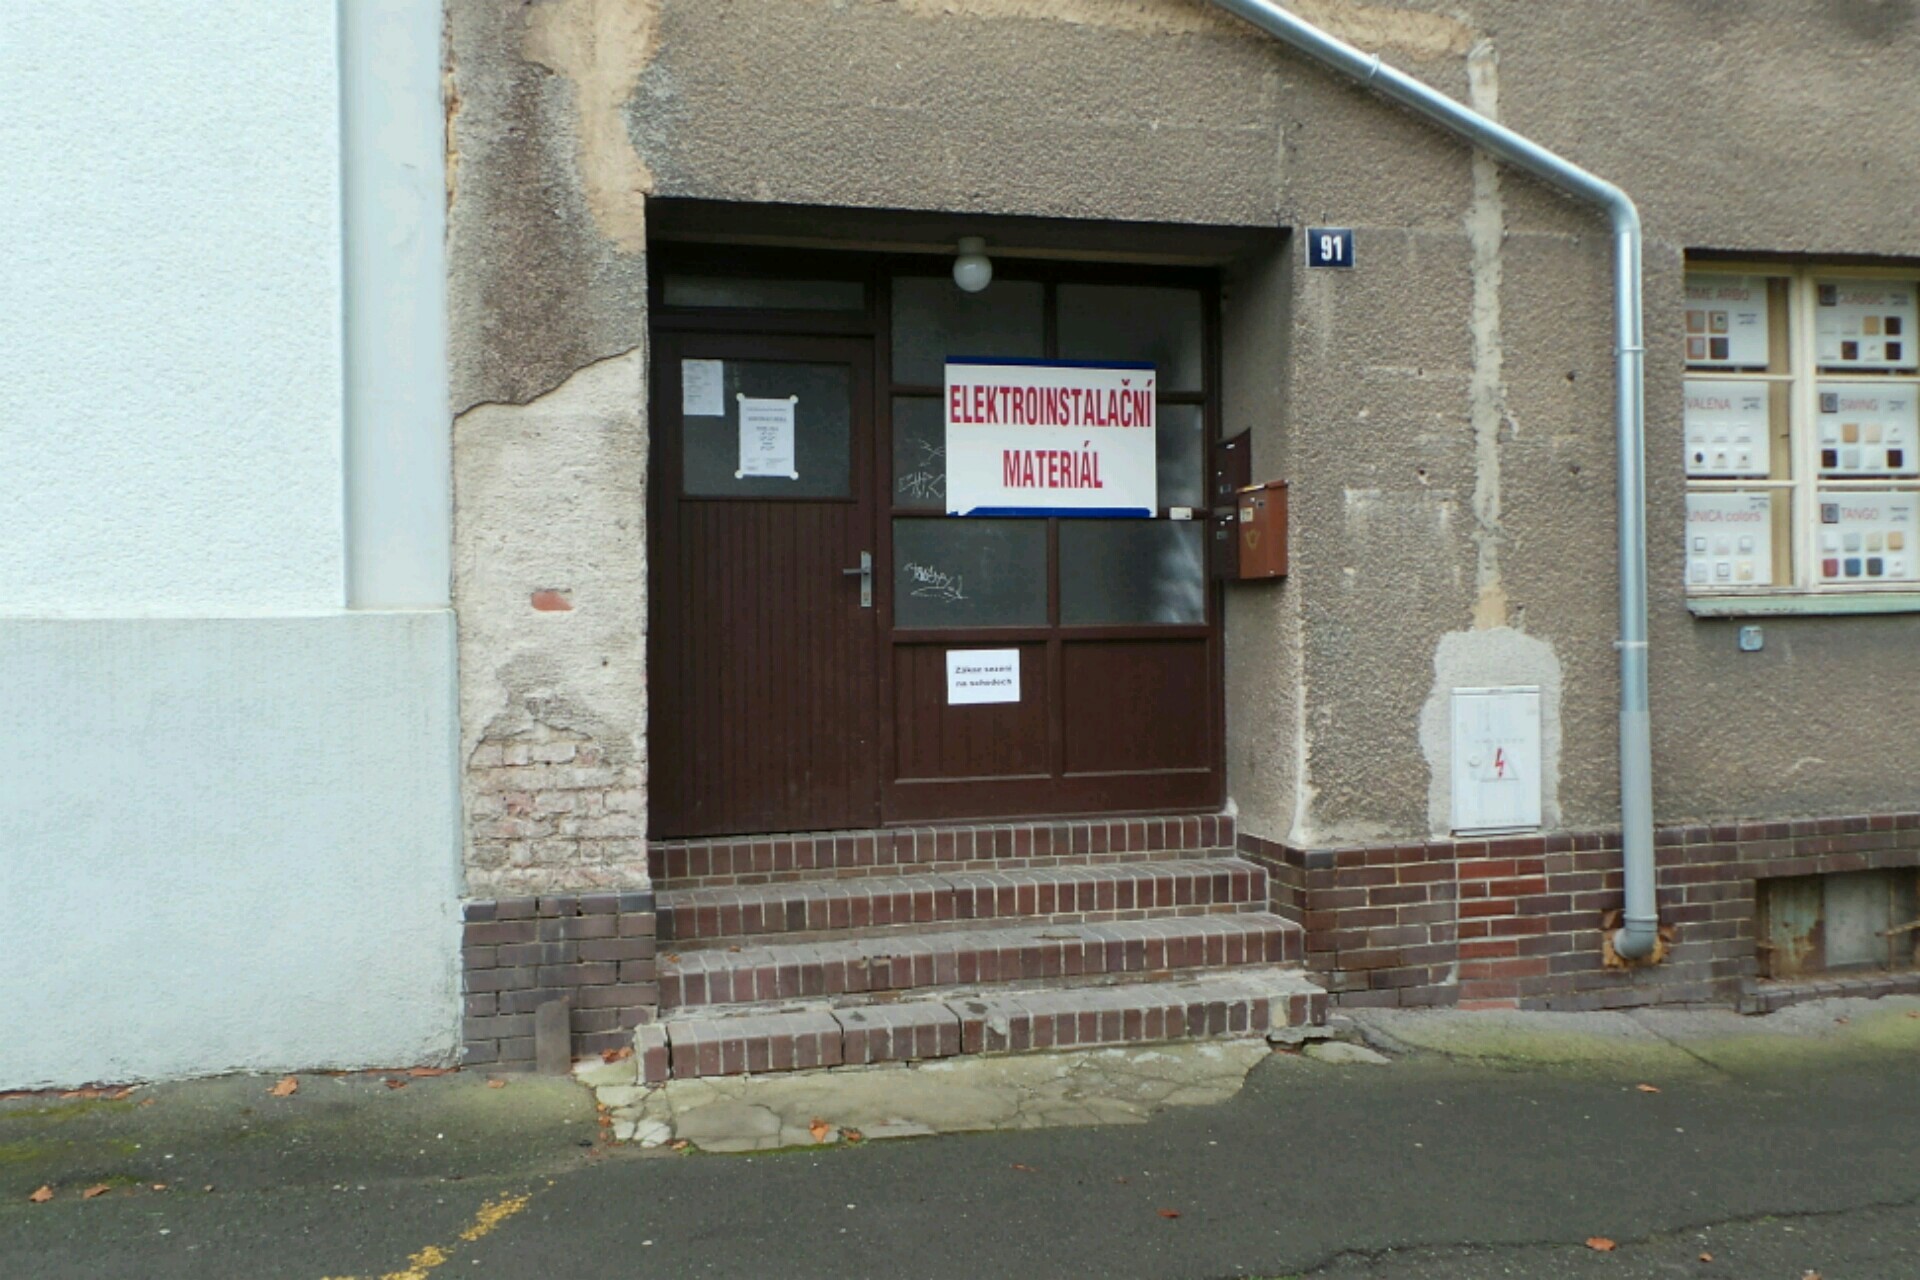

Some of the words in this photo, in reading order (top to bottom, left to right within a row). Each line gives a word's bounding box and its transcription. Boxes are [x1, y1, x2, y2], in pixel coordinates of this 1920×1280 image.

[1321, 235, 1342, 261] 91
[950, 379, 1153, 427] ELEKTROINSTALAČNÍ
[1687, 397, 1731, 410] VALENA
[1840, 398, 1878, 412] SWING
[1003, 440, 1103, 489] MATERIÁL
[1840, 506, 1879, 520] TANGO
